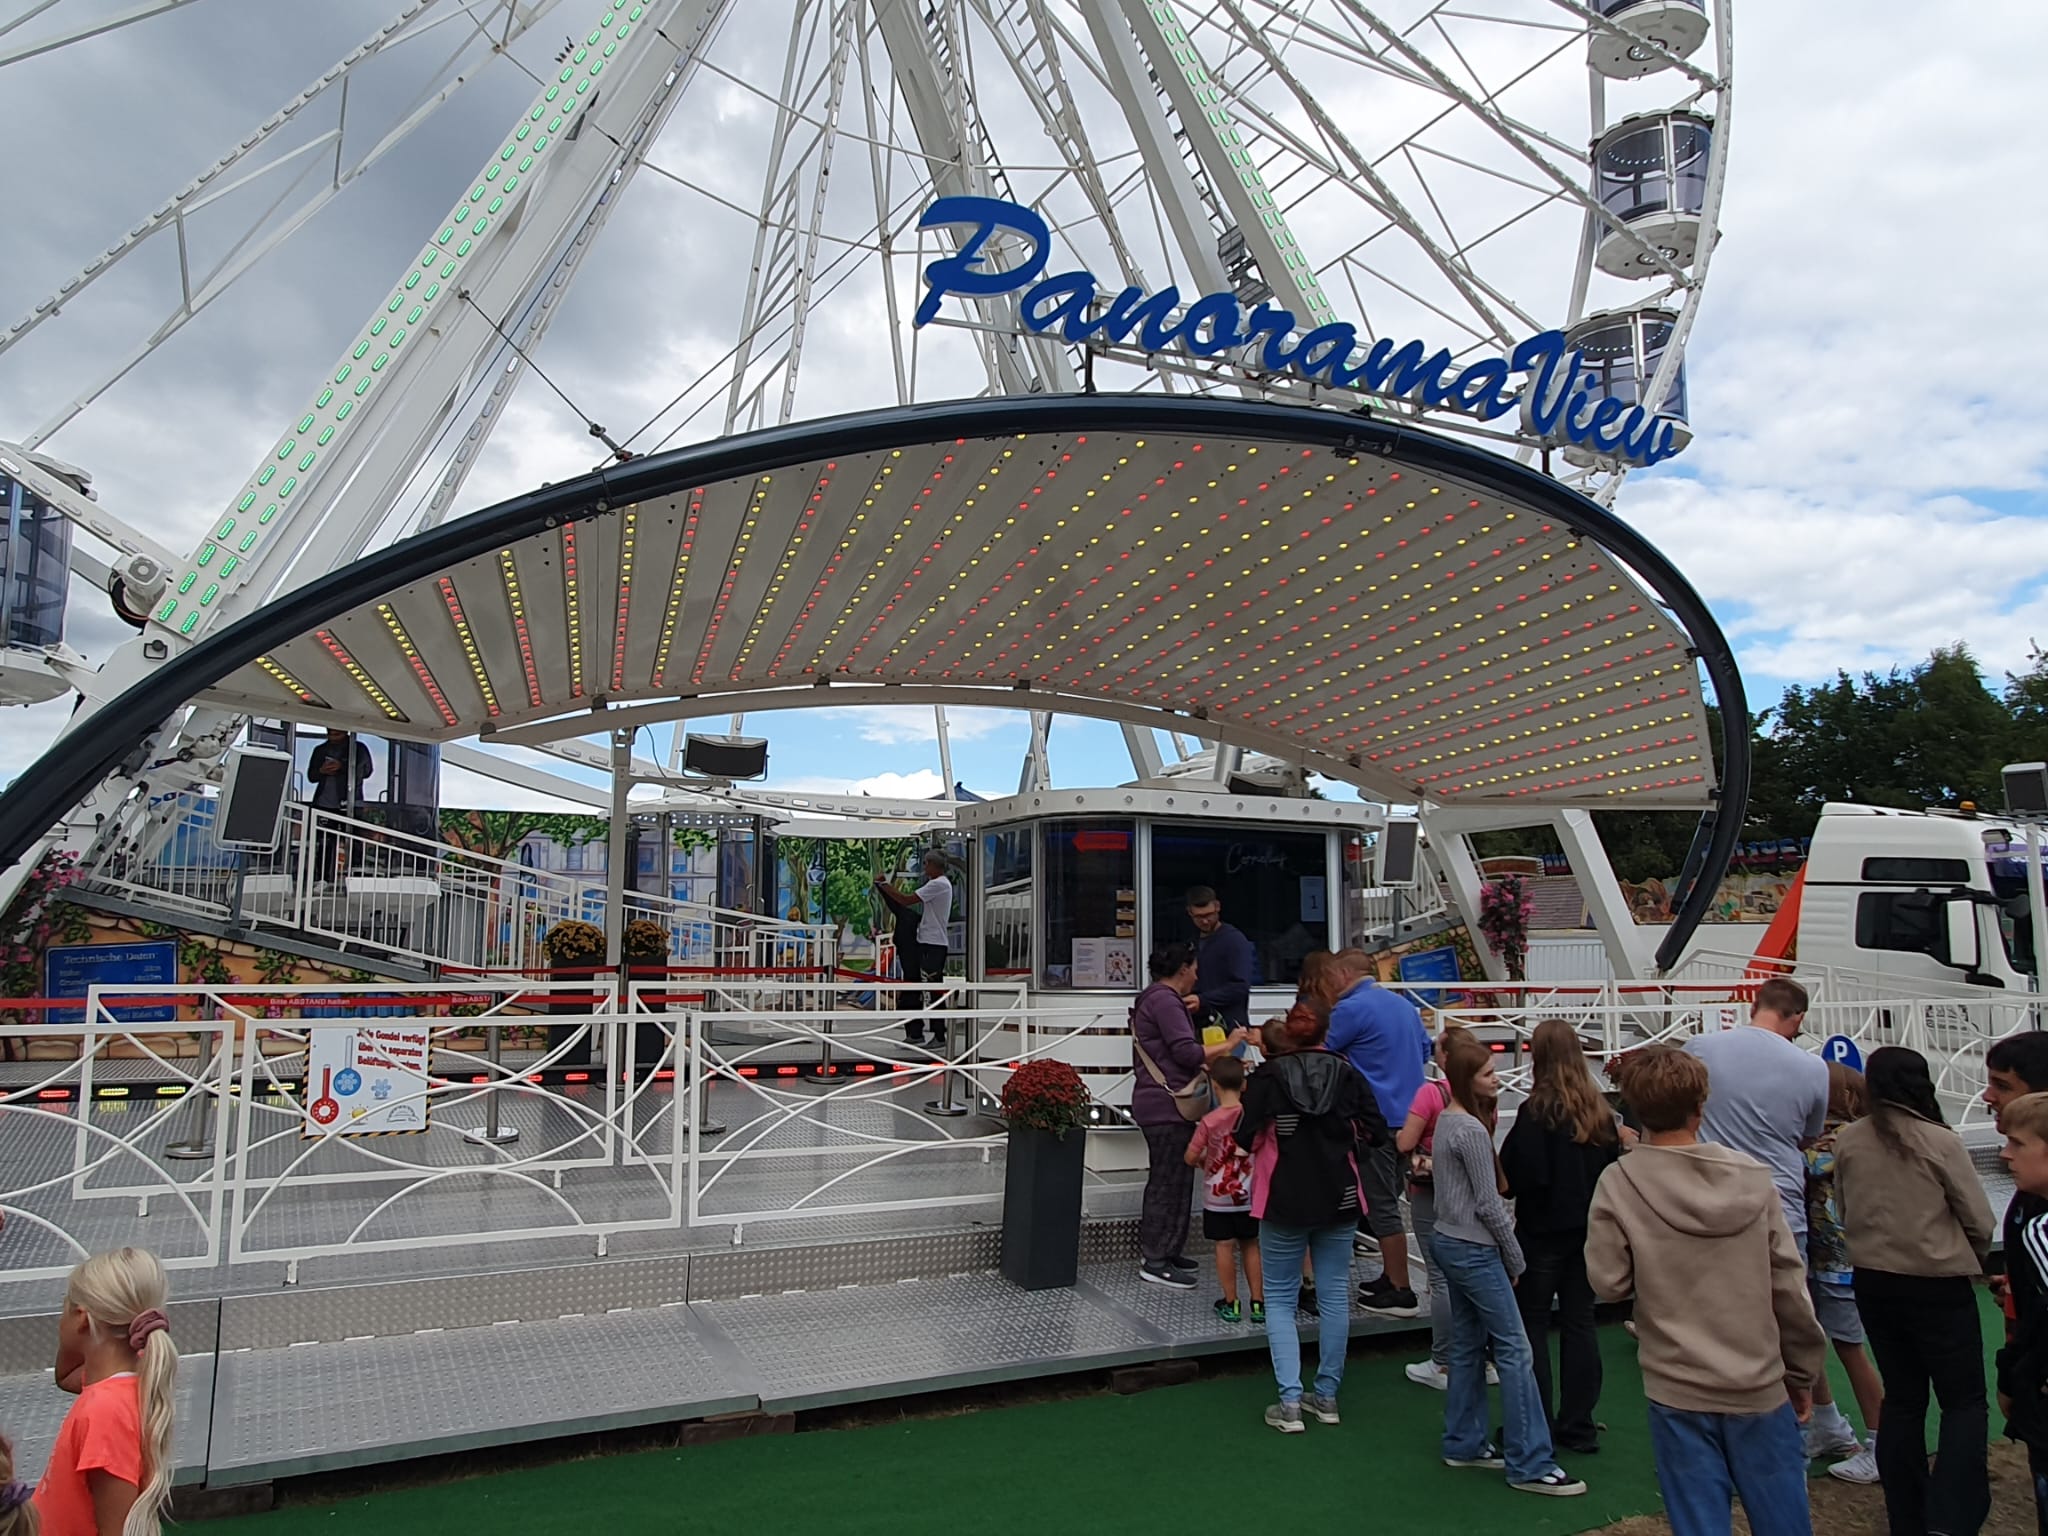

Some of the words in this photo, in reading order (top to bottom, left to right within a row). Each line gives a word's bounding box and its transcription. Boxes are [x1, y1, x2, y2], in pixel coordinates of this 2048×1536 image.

[63, 953, 122, 964] Technische
[376, 1030, 400, 1041] Gondel
[402, 1034, 426, 1046] verfügt
[358, 1042, 373, 1052] über
[389, 1046, 423, 1057] separates
[1833, 1041, 1848, 1062] P
